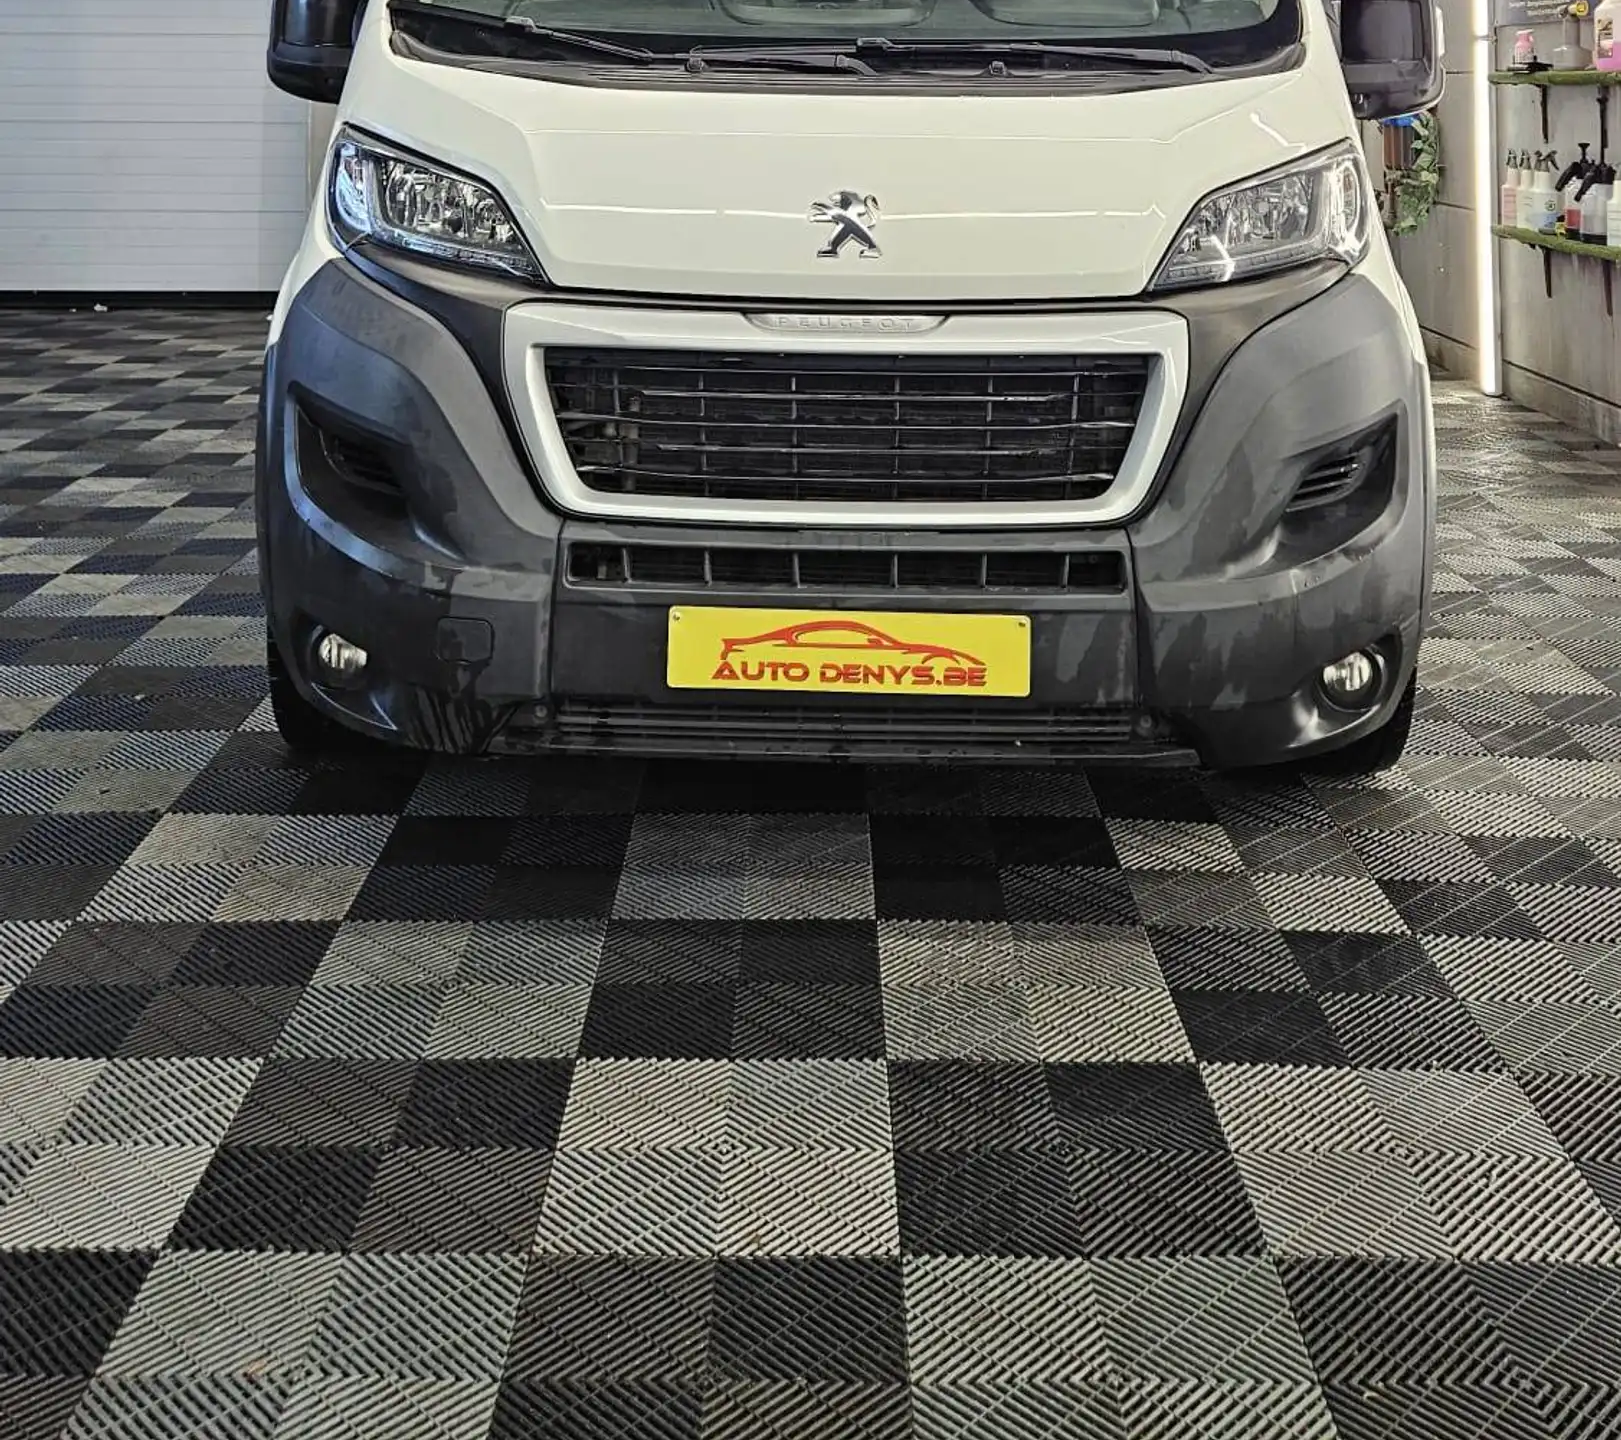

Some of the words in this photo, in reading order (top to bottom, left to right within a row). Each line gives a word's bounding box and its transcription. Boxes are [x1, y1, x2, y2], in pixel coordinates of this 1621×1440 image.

[777, 316, 914, 330] PEUGEOT
[711, 660, 810, 681] AUTO
[819, 662, 988, 687] DENYS.BE
